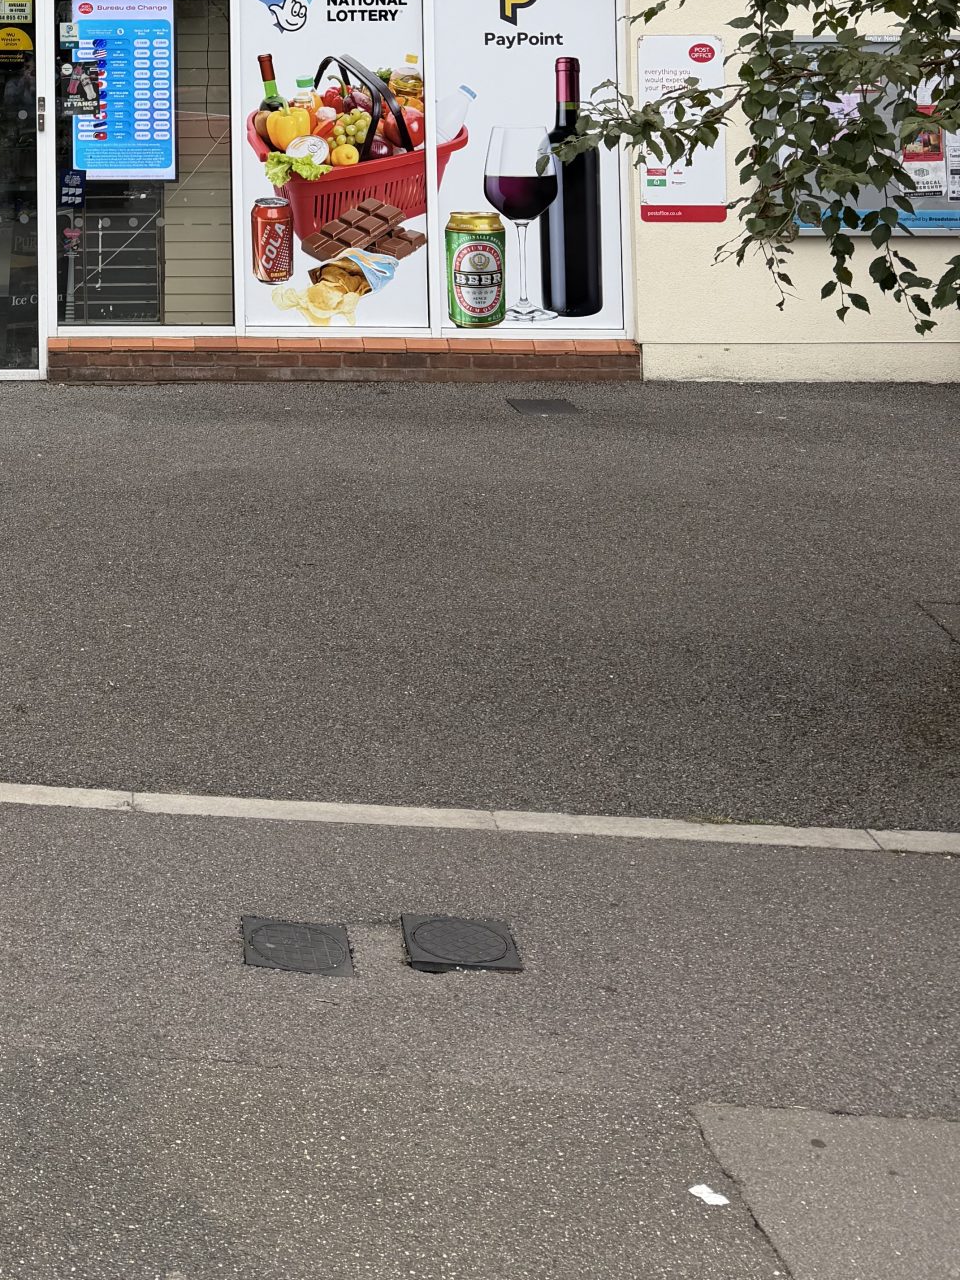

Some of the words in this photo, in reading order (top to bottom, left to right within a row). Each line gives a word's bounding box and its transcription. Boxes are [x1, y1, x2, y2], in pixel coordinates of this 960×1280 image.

[326, 9, 399, 22] LOTTERY
[484, 32, 564, 49] PayPoint
[261, 225, 271, 246] FRESH
[262, 223, 286, 269] COLA
[455, 273, 501, 286] BEER
[11, 296, 27, 306] Ice
